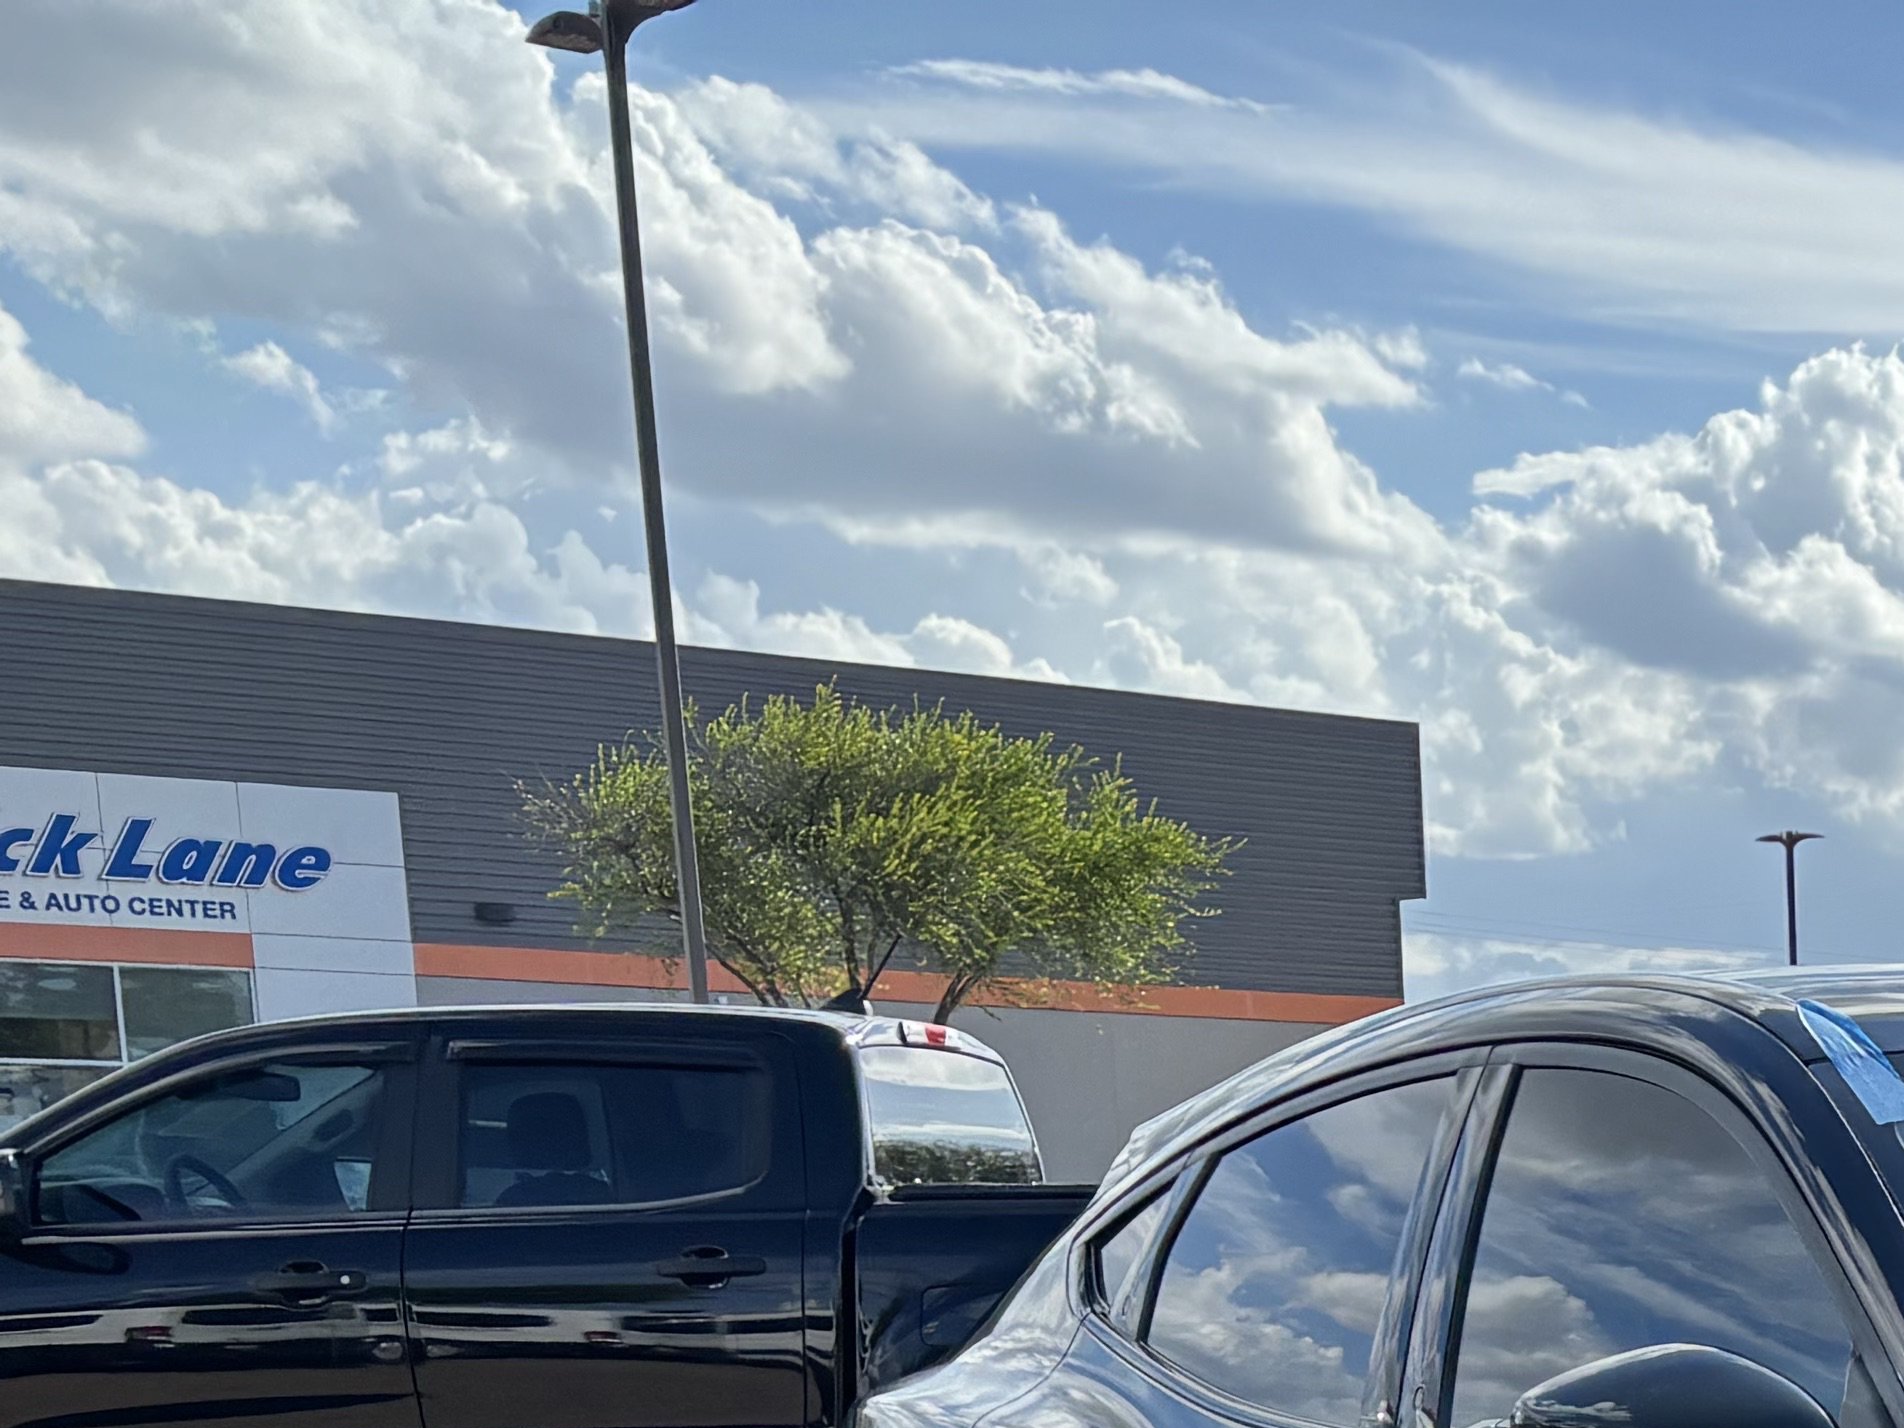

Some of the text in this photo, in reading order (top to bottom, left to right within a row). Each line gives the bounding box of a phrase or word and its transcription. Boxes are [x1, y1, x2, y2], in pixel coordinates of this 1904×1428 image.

[101, 816, 332, 891] Lane
[19, 891, 37, 910] &
[45, 893, 120, 914] AUTO
[128, 897, 237, 920] CENTER
